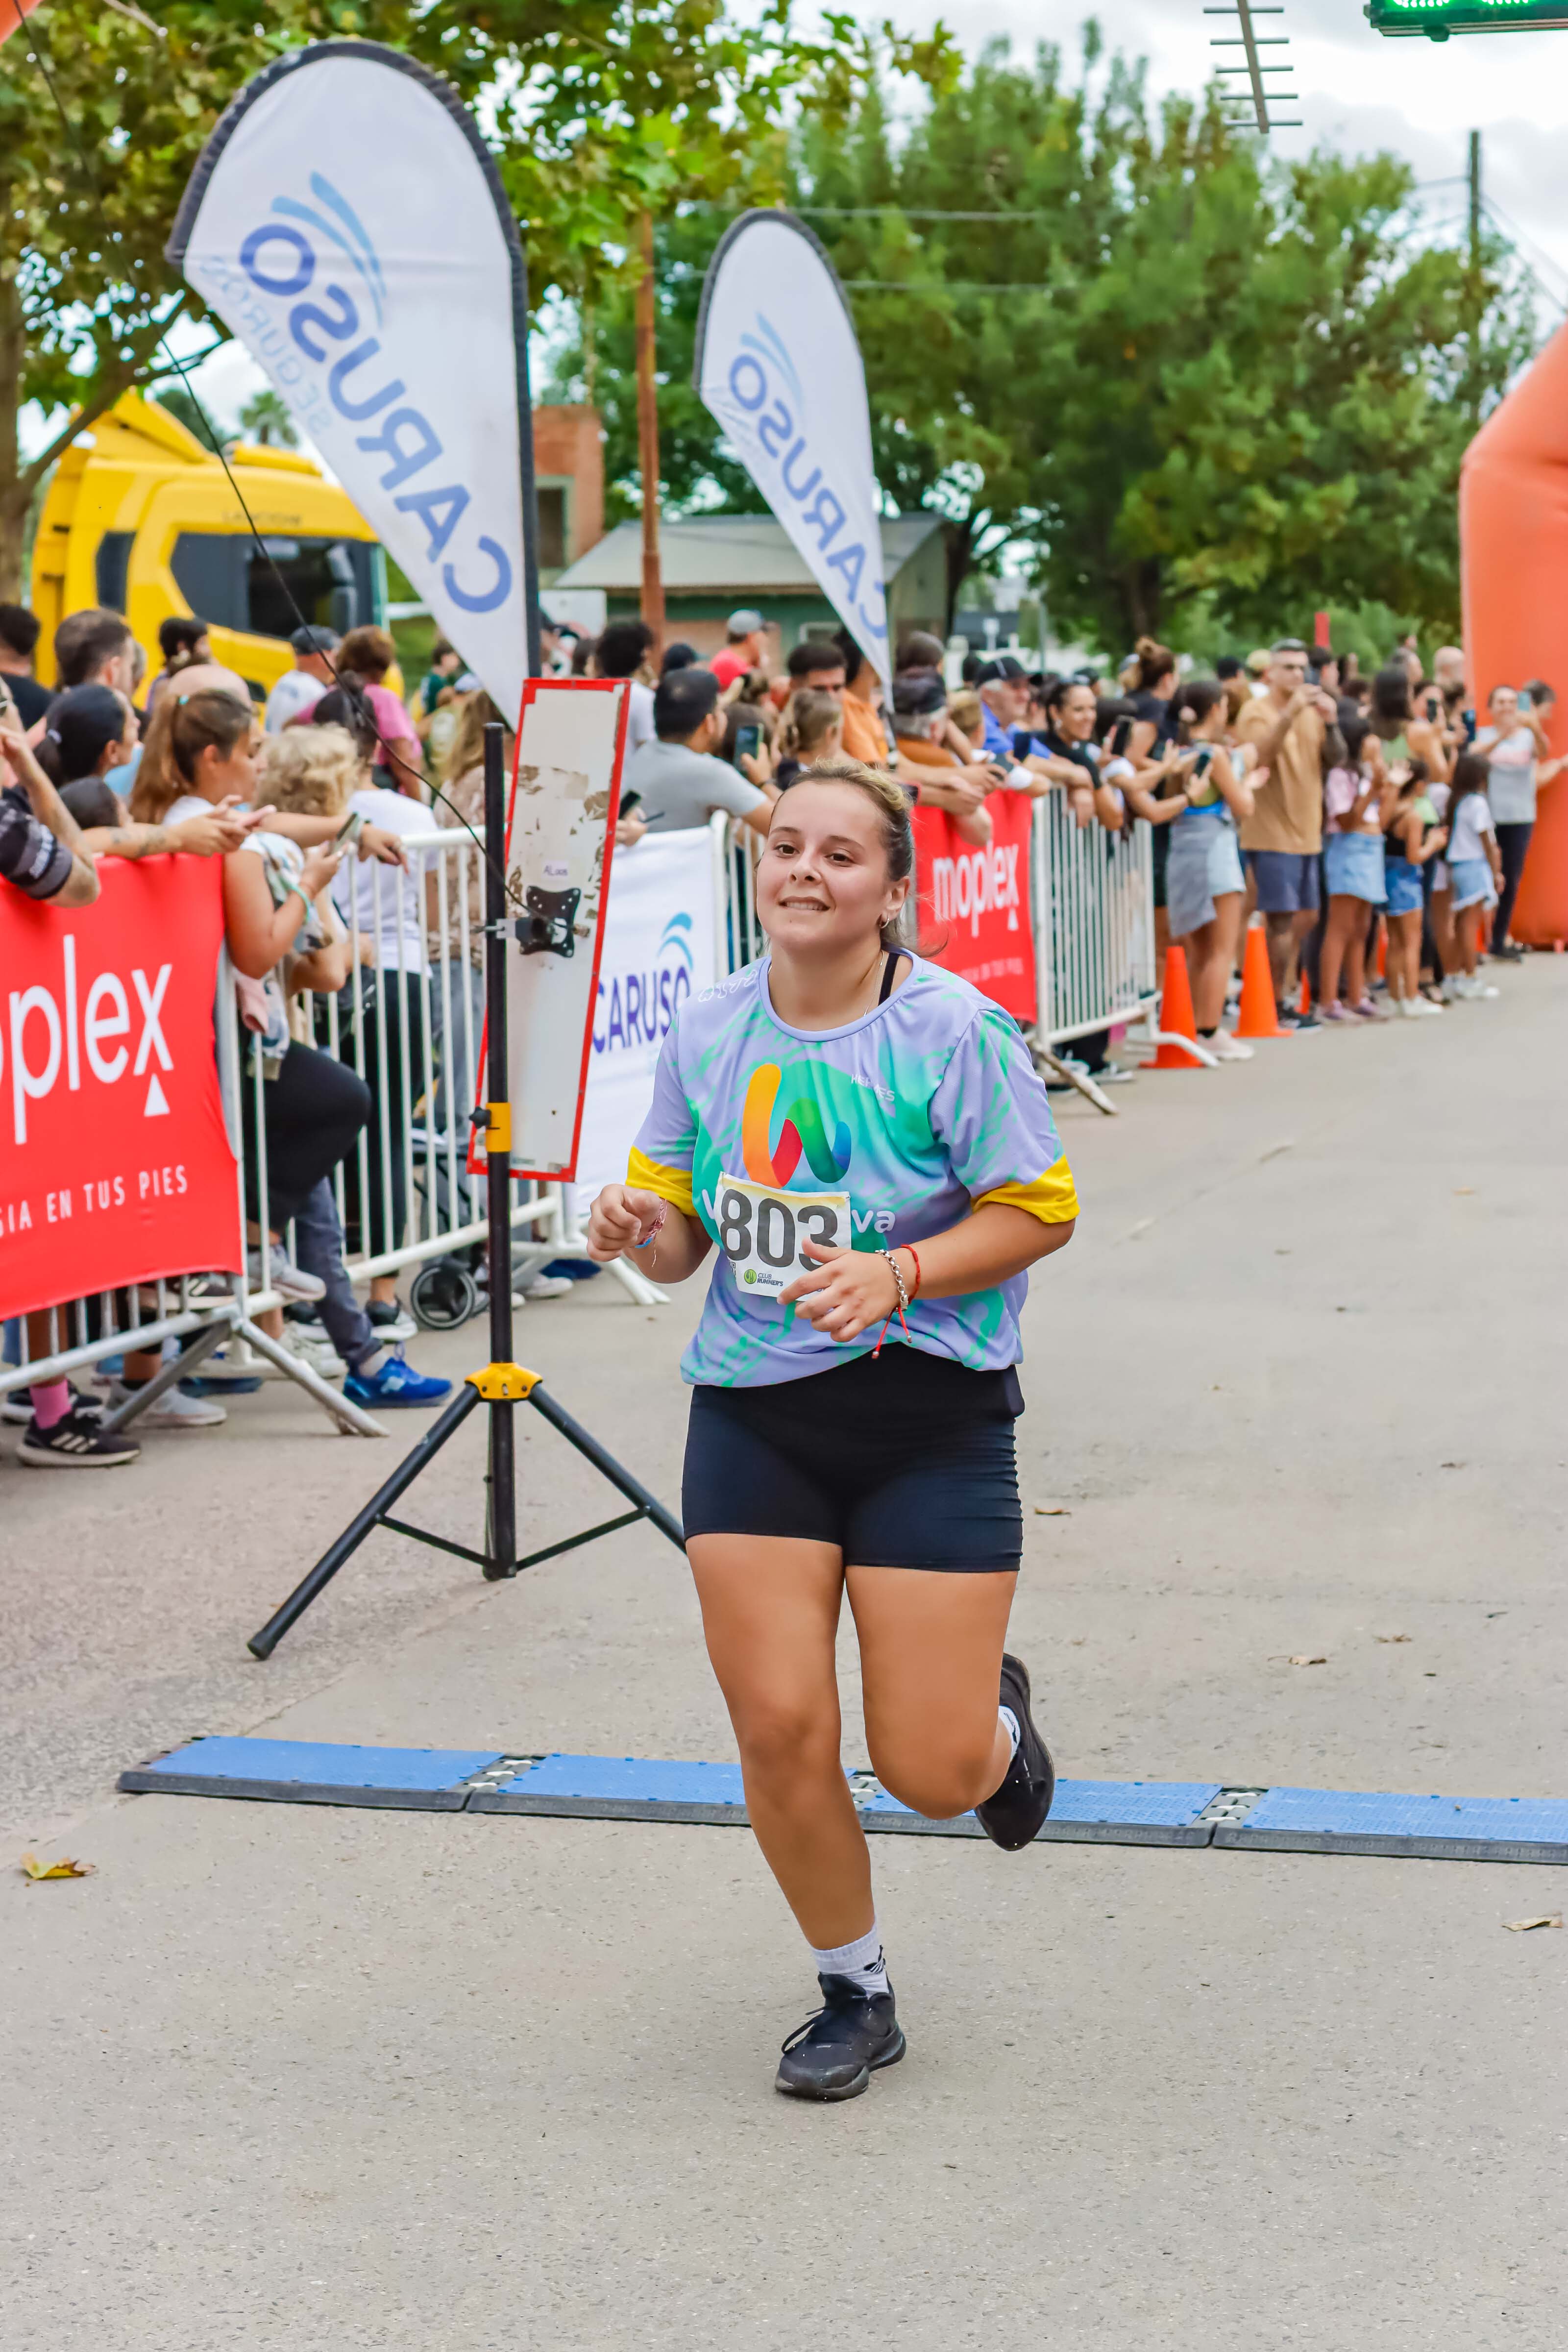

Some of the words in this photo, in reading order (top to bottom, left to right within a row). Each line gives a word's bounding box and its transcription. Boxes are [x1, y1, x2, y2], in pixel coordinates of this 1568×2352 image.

[933, 839, 1019, 938] moplex
[0, 934, 174, 1145] plex
[47, 1189, 72, 1223] EN
[83, 1176, 125, 1213] TUS
[139, 1164, 188, 1200] PIES
[720, 1189, 838, 1272] 803
[757, 1278, 784, 1287] RUNNER'S
